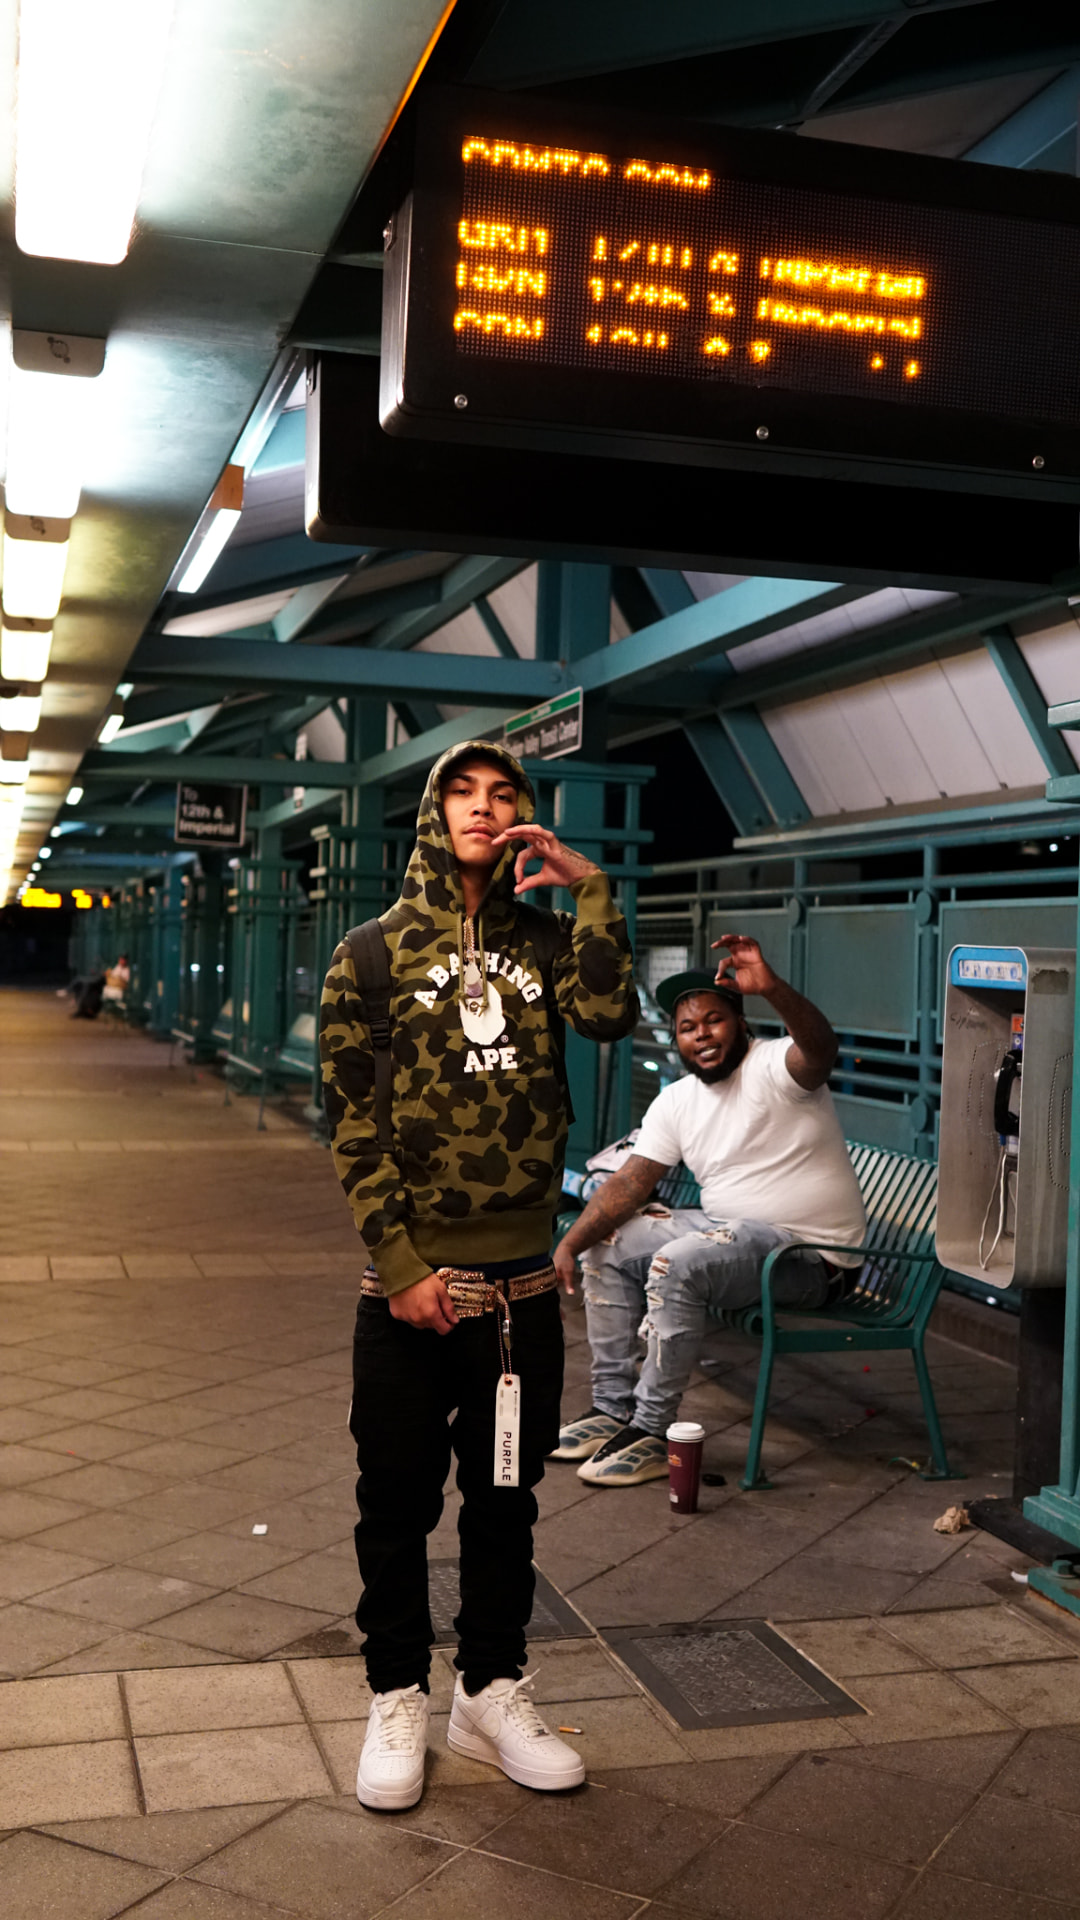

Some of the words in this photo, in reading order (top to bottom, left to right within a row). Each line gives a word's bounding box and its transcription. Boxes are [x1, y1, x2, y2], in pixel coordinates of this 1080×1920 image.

[183, 787, 198, 801] To
[182, 804, 211, 818] 12th
[179, 819, 236, 836] Imperial
[414, 989, 438, 1010] A
[464, 1047, 518, 1073] APE
[502, 1431, 512, 1481] PURPLE
